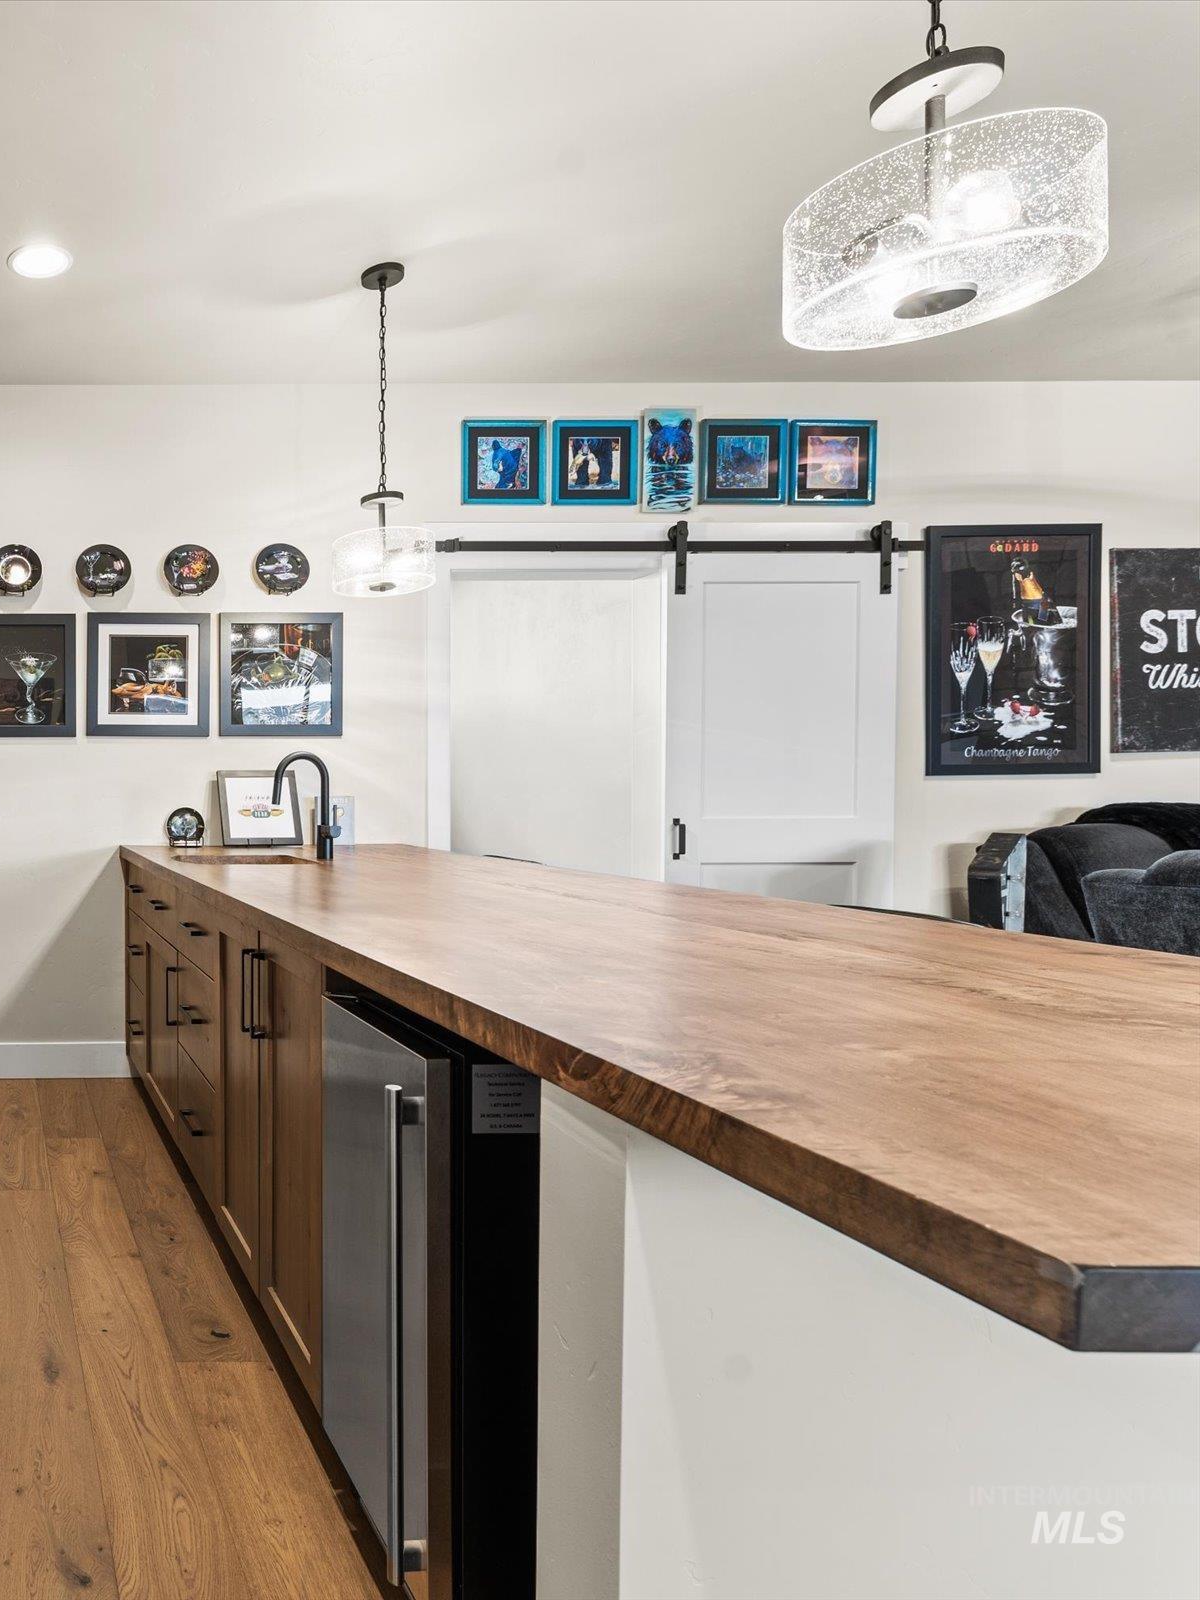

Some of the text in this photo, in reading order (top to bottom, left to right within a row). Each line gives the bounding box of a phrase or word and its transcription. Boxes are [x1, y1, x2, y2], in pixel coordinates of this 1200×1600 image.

[1139, 609, 1200, 654] ST
[1142, 663, 1200, 690] Whi
[964, 745, 1061, 761] Champagne Tango
